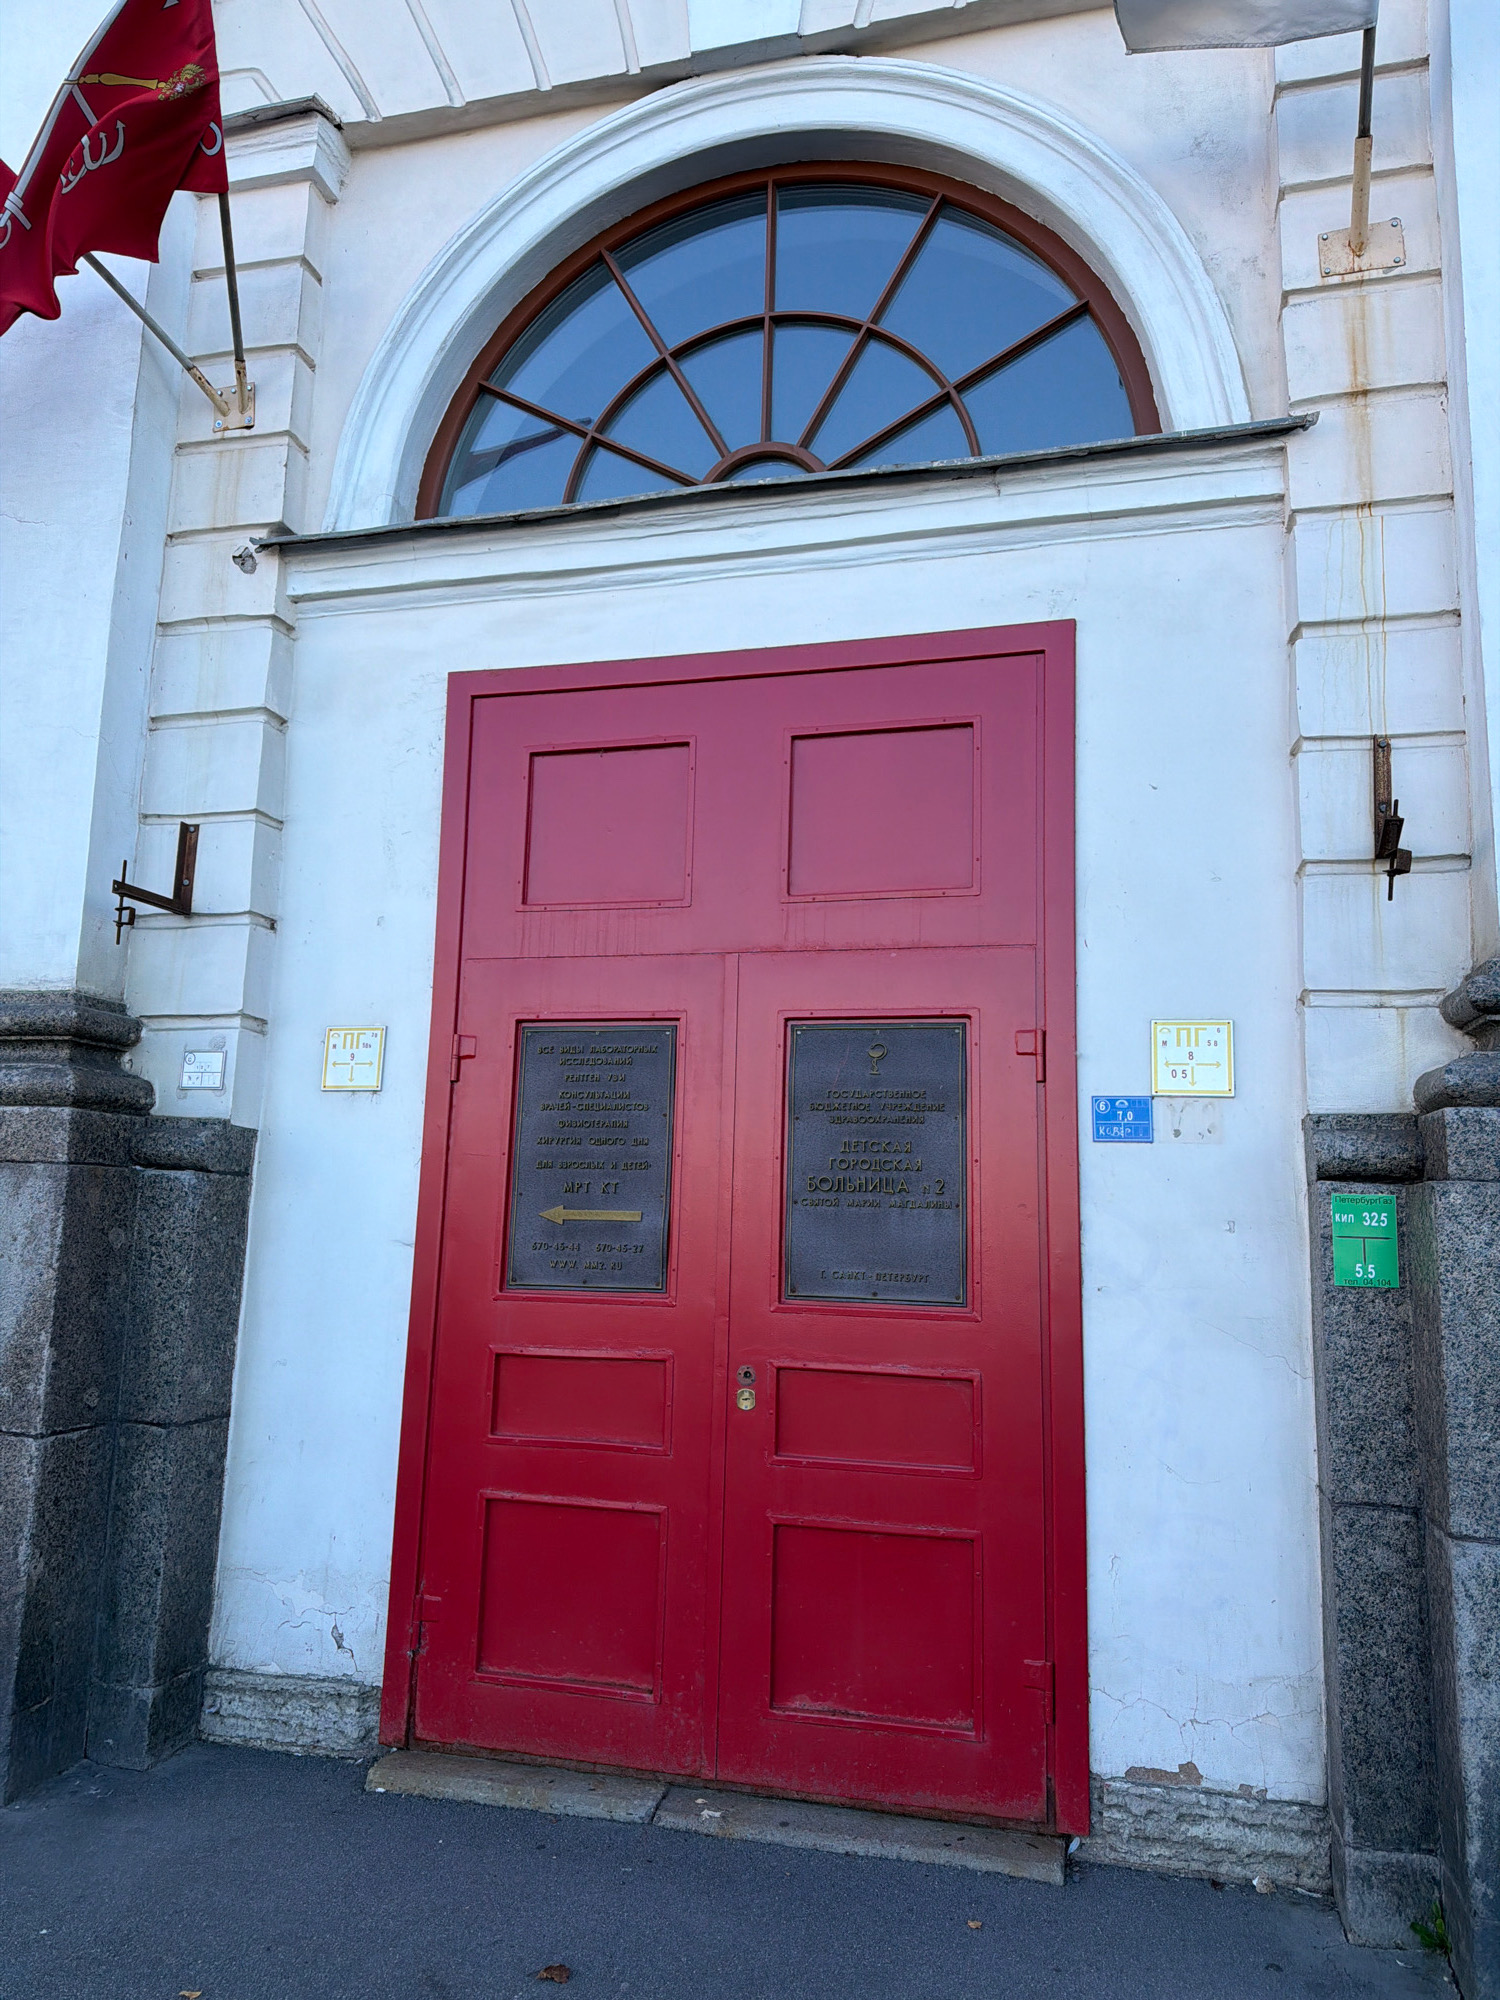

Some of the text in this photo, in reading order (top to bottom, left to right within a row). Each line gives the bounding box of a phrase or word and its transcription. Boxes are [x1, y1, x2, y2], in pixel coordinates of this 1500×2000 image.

[342, 1032, 366, 1049] ПГ
[1176, 1028, 1207, 1047] ПГ
[538, 1046, 554, 1054] ВСЕ
[590, 1046, 658, 1054] ЛАБОРАТОРНЫХ
[350, 1053, 354, 1061] 9
[1188, 1051, 1194, 1060] 8
[560, 1056, 632, 1066] ИССЛЕДОВАНИЙ
[565, 1074, 626, 1082] РЕНТГЕН УЗИ
[560, 1091, 630, 1100] КОНСУЛЬТАЦИИ
[826, 1090, 926, 1099] ГОСУДАРСТВЕННОЕ
[809, 1103, 945, 1112] БЮДЖЕТНОЕ УЧРЕЖДЕНИЕ
[1100, 1102, 1106, 1110] 6
[558, 1120, 628, 1128] ФИЗИОТЕРАПИЯ
[829, 1116, 925, 1124] ЗДРАВООХРАНЕНИЯ
[537, 1137, 649, 1146] ХИРУРГИЯ ОДНОГО ДНЯ
[840, 1140, 912, 1153] ДЕТСКАЯ
[536, 1160, 553, 1169] ДЛЯ
[558, 1161, 604, 1170] ВЗРОСЛЫХ
[622, 1160, 648, 1170] ДЕТЕЙ
[829, 1158, 922, 1172] ГОРОДСКАЯ
[564, 1182, 618, 1194] МРТ КТ
[806, 1176, 910, 1194] БОЛЬНИЦА
[935, 1178, 944, 1194] 2
[800, 1198, 952, 1210] СВЯТОЙ МАРИИ МАГДАЛИНЫ
[1362, 1212, 1388, 1226] 325
[1356, 1264, 1376, 1278] 5.5
